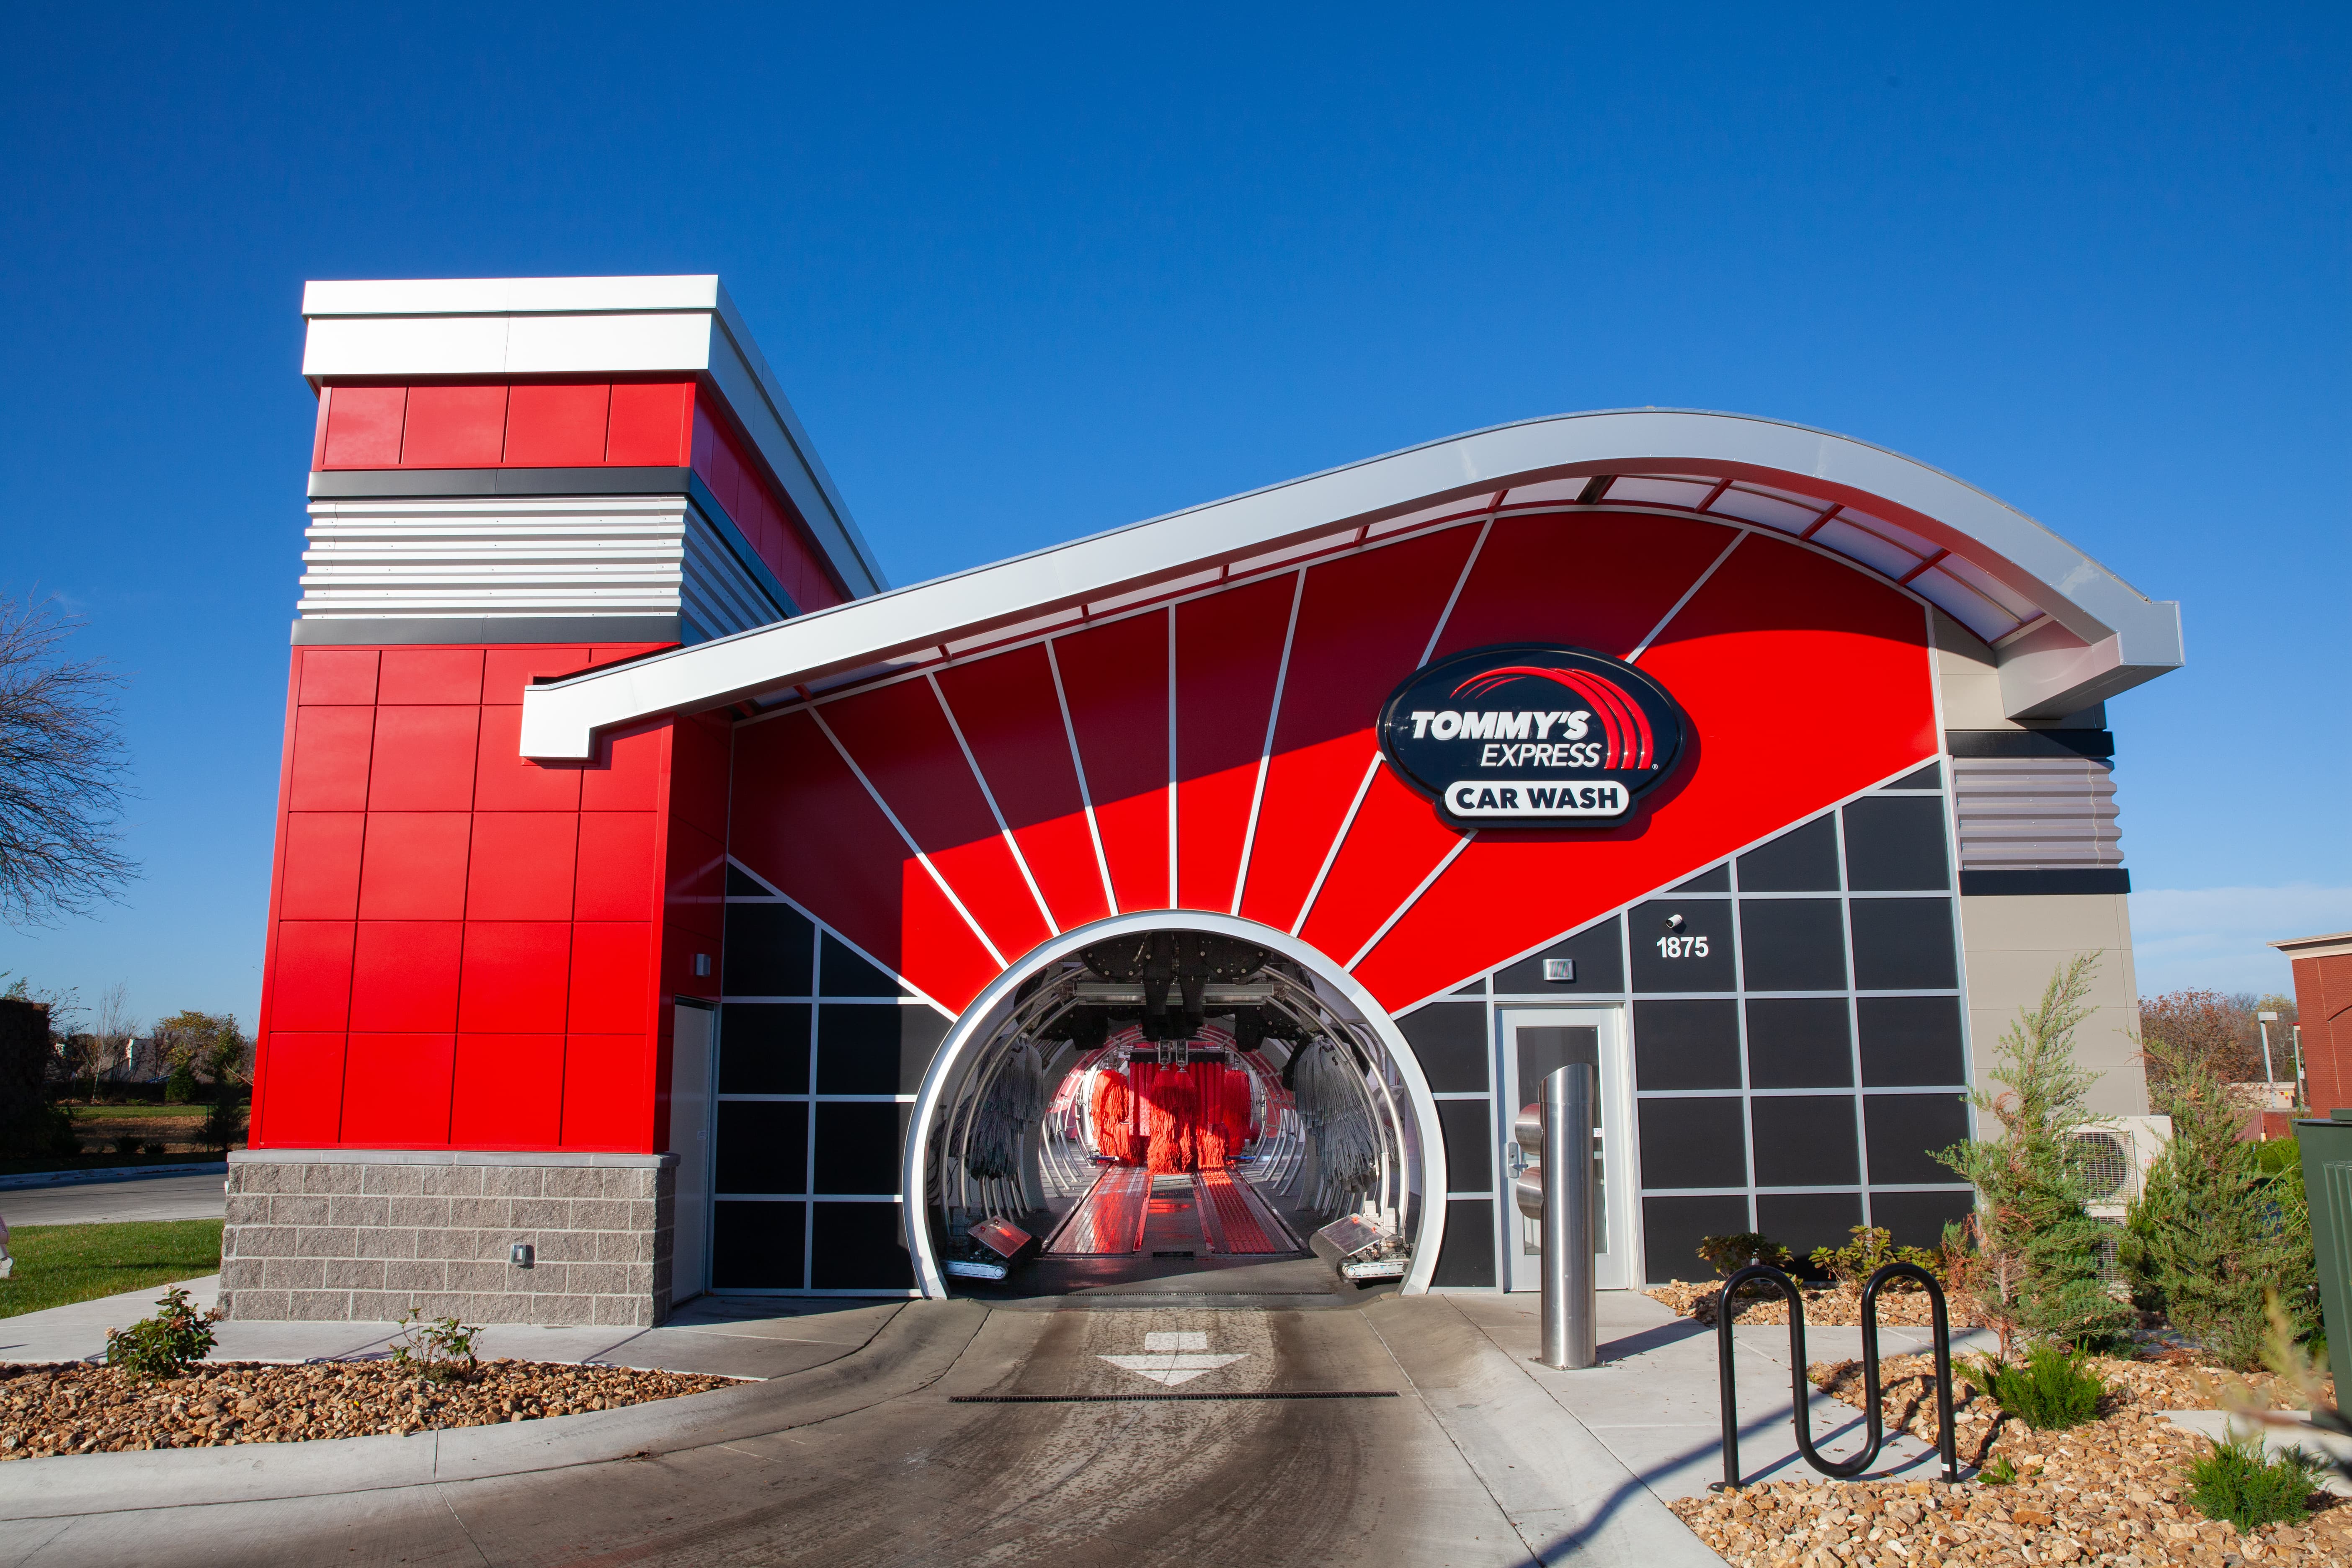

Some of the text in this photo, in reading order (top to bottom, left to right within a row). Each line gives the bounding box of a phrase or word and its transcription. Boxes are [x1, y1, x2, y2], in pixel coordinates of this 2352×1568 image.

[1411, 710, 1591, 740] TOMMY'S
[1480, 743, 1602, 768] EXPRESS
[1456, 788, 1618, 809] CAR WASH
[1656, 936, 1709, 958] 1875
